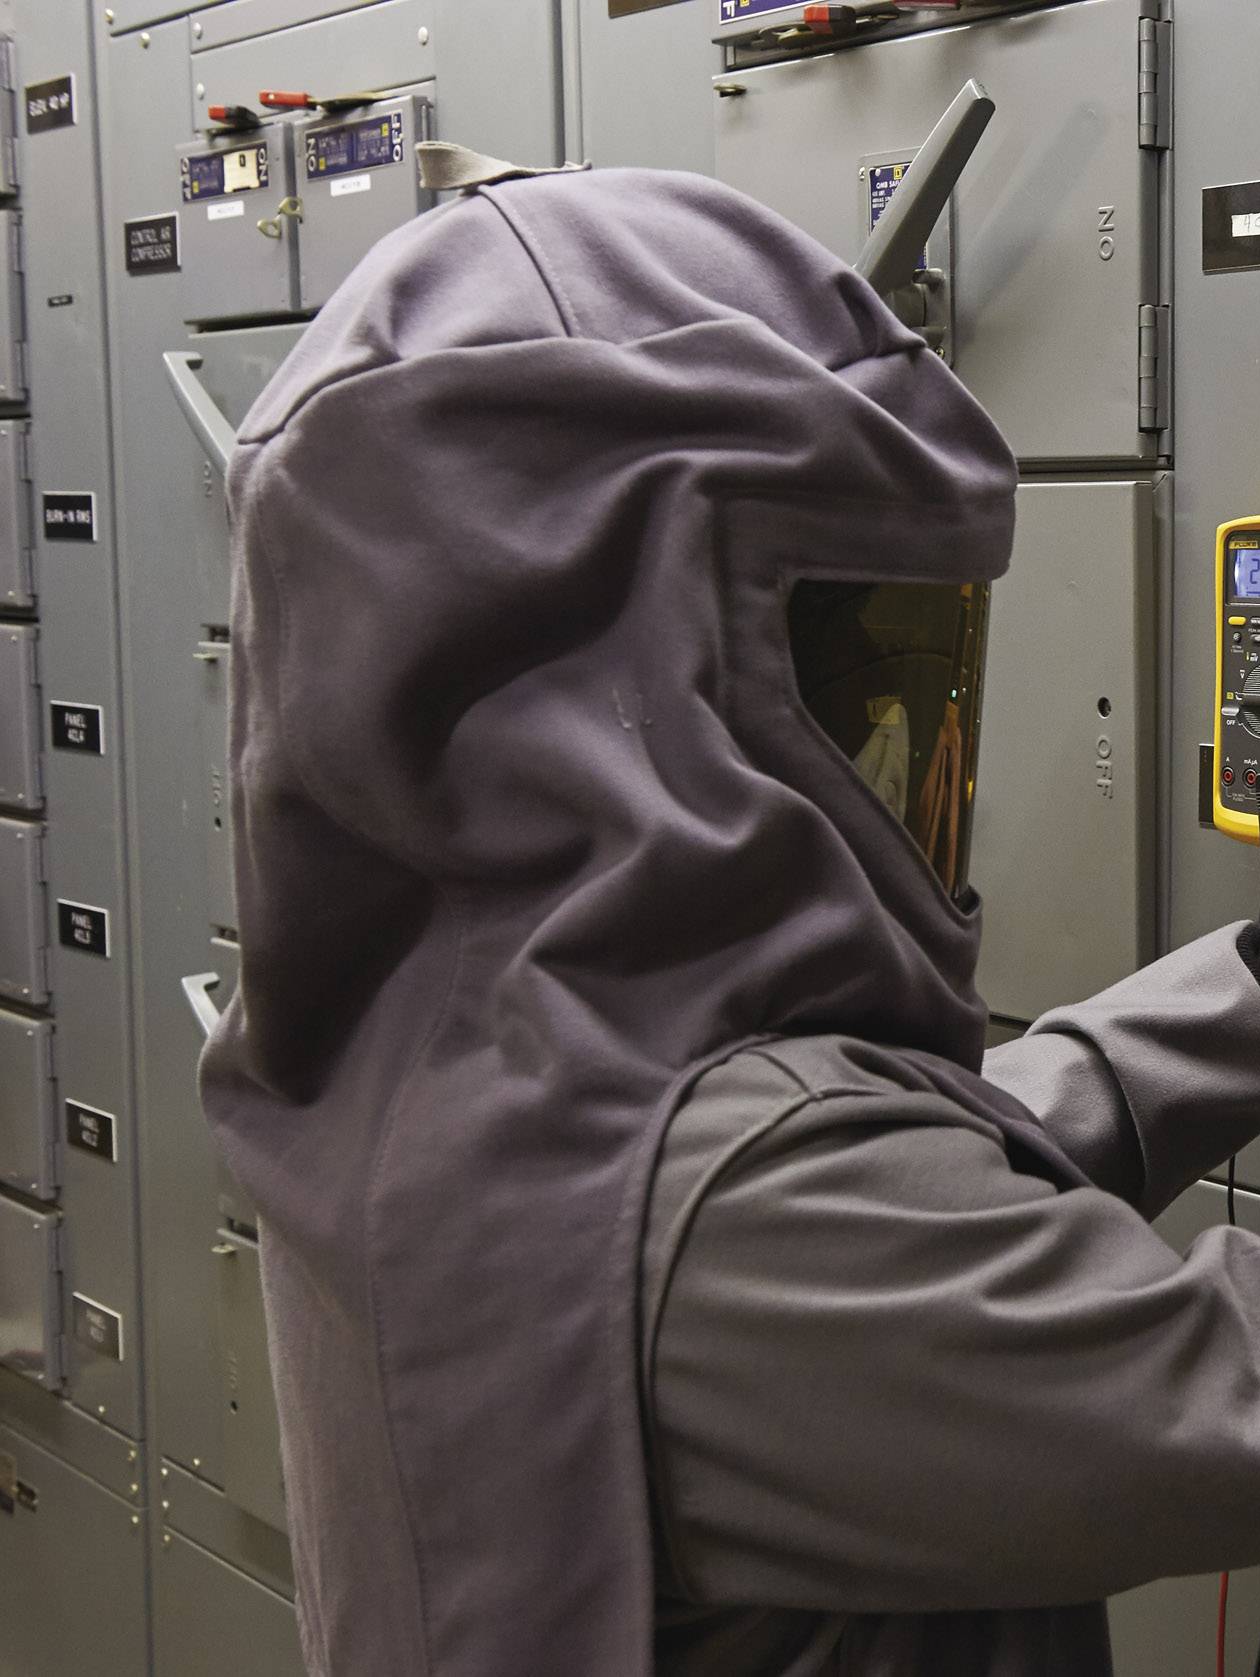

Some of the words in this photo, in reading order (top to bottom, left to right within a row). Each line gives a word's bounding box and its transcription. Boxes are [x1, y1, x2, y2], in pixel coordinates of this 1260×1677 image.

[307, 138, 317, 171] ON
[392, 112, 404, 161] OFF
[180, 158, 191, 200] OFF
[257, 148, 268, 181] ON
[1098, 205, 1115, 261] ON
[64, 712, 86, 729] PANEL
[1096, 735, 1113, 799] OFF
[70, 912, 92, 930] PANEL
